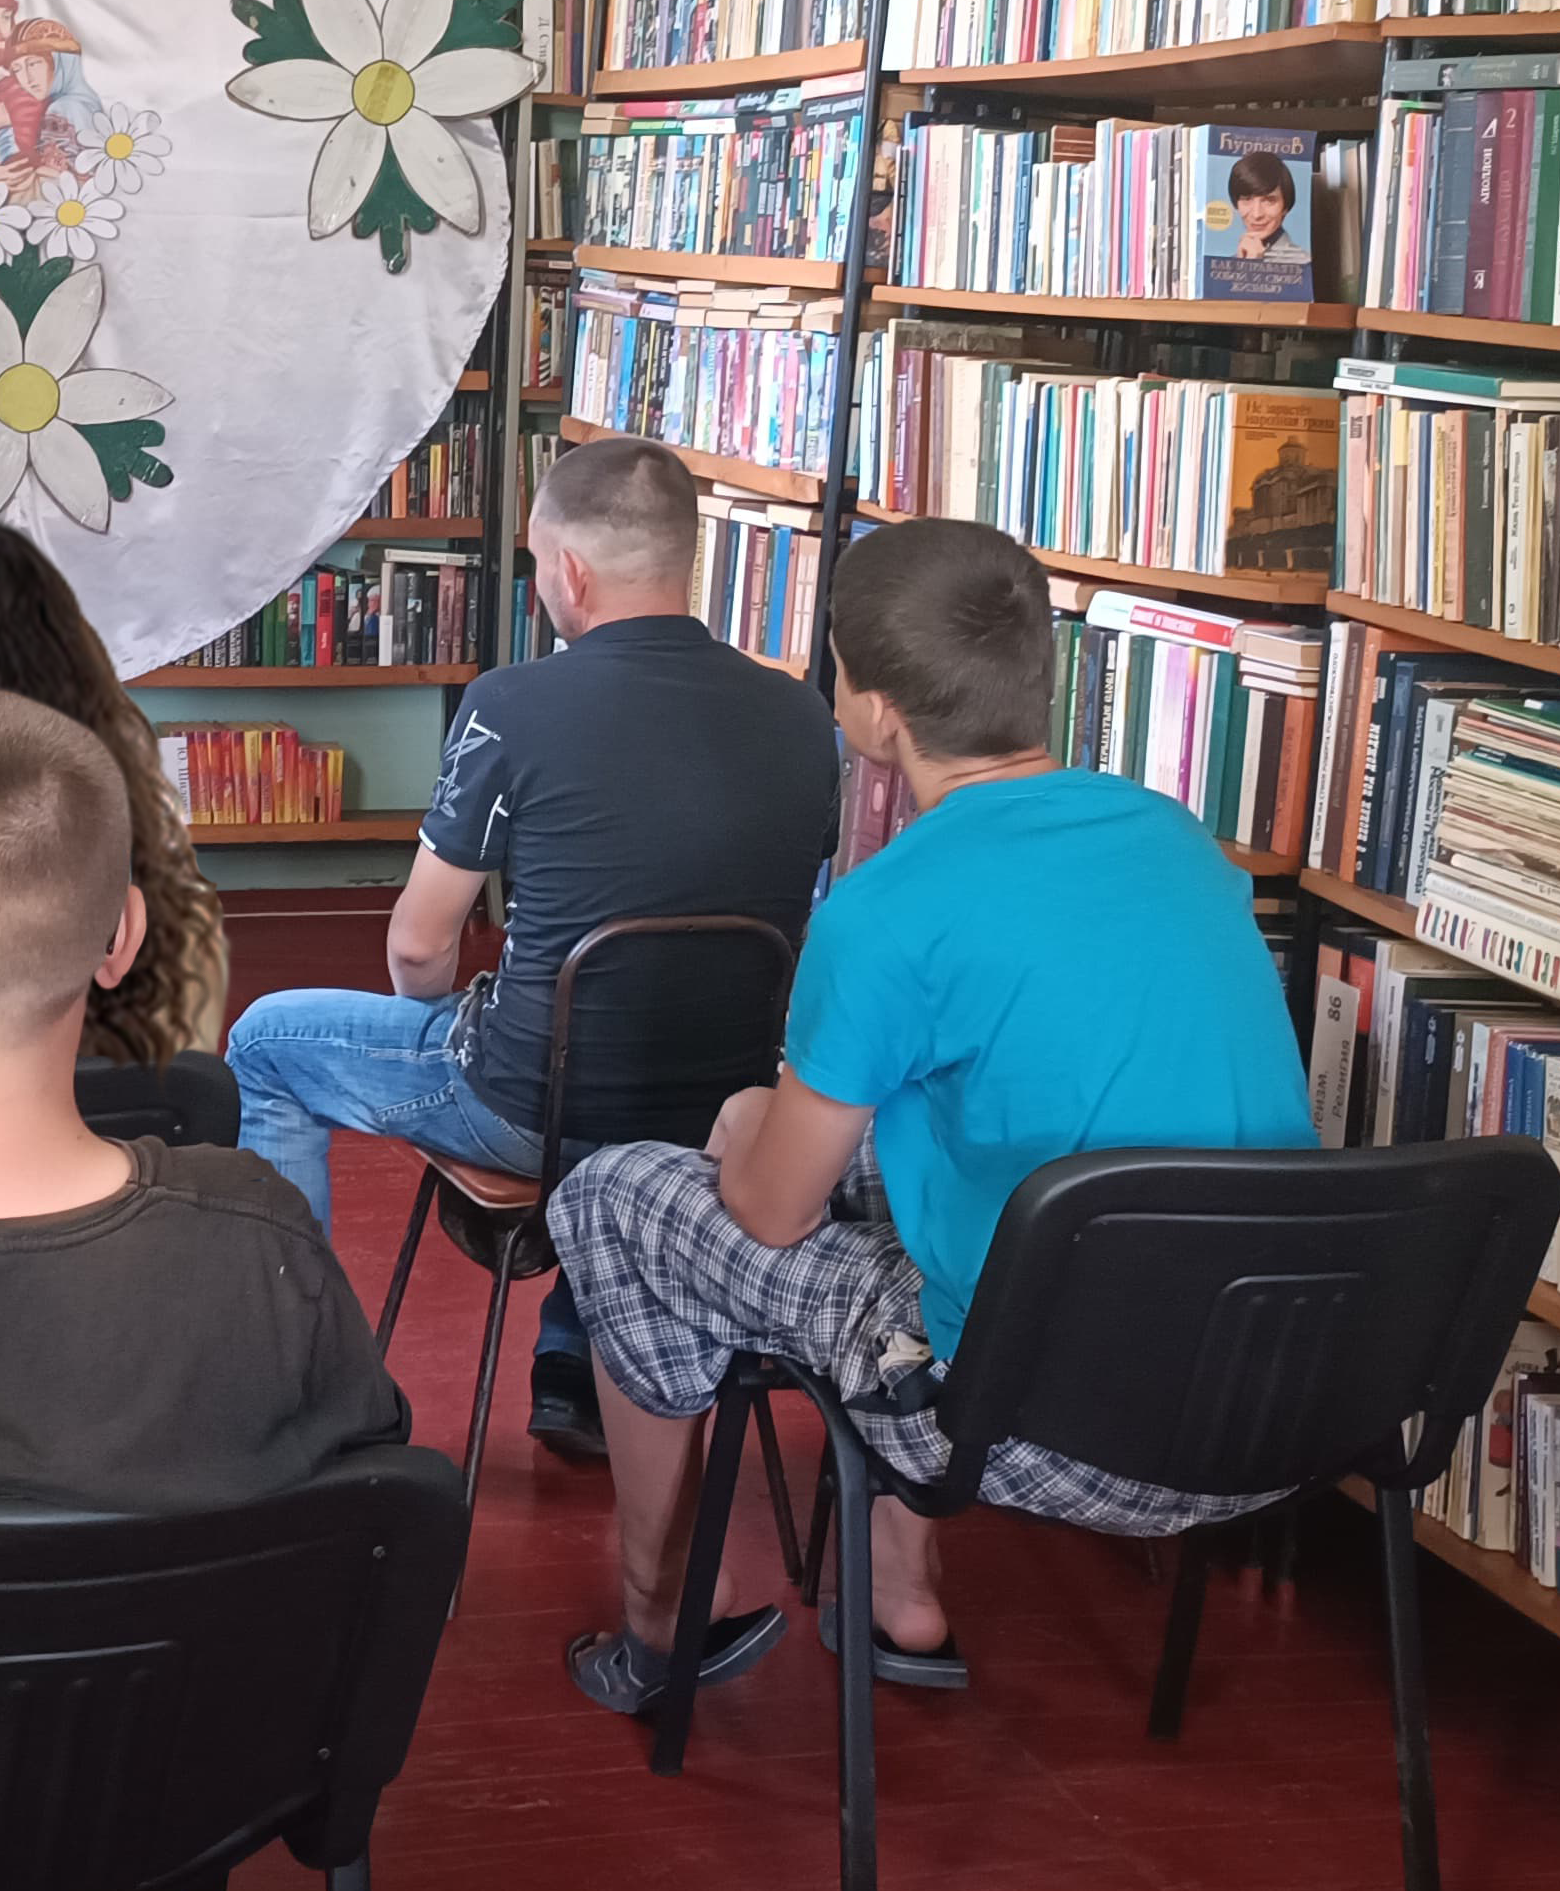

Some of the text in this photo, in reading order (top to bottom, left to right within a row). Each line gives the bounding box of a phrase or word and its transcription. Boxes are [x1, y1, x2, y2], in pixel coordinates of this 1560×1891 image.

[1506, 108, 1515, 129] 2
[1480, 148, 1493, 205] АПОЛЛОН
[1414, 823, 1429, 893] Петрограда
[1328, 996, 1343, 1022] 86
[1313, 1071, 1328, 1137] теизм.
[1332, 1040, 1351, 1118] Религия
